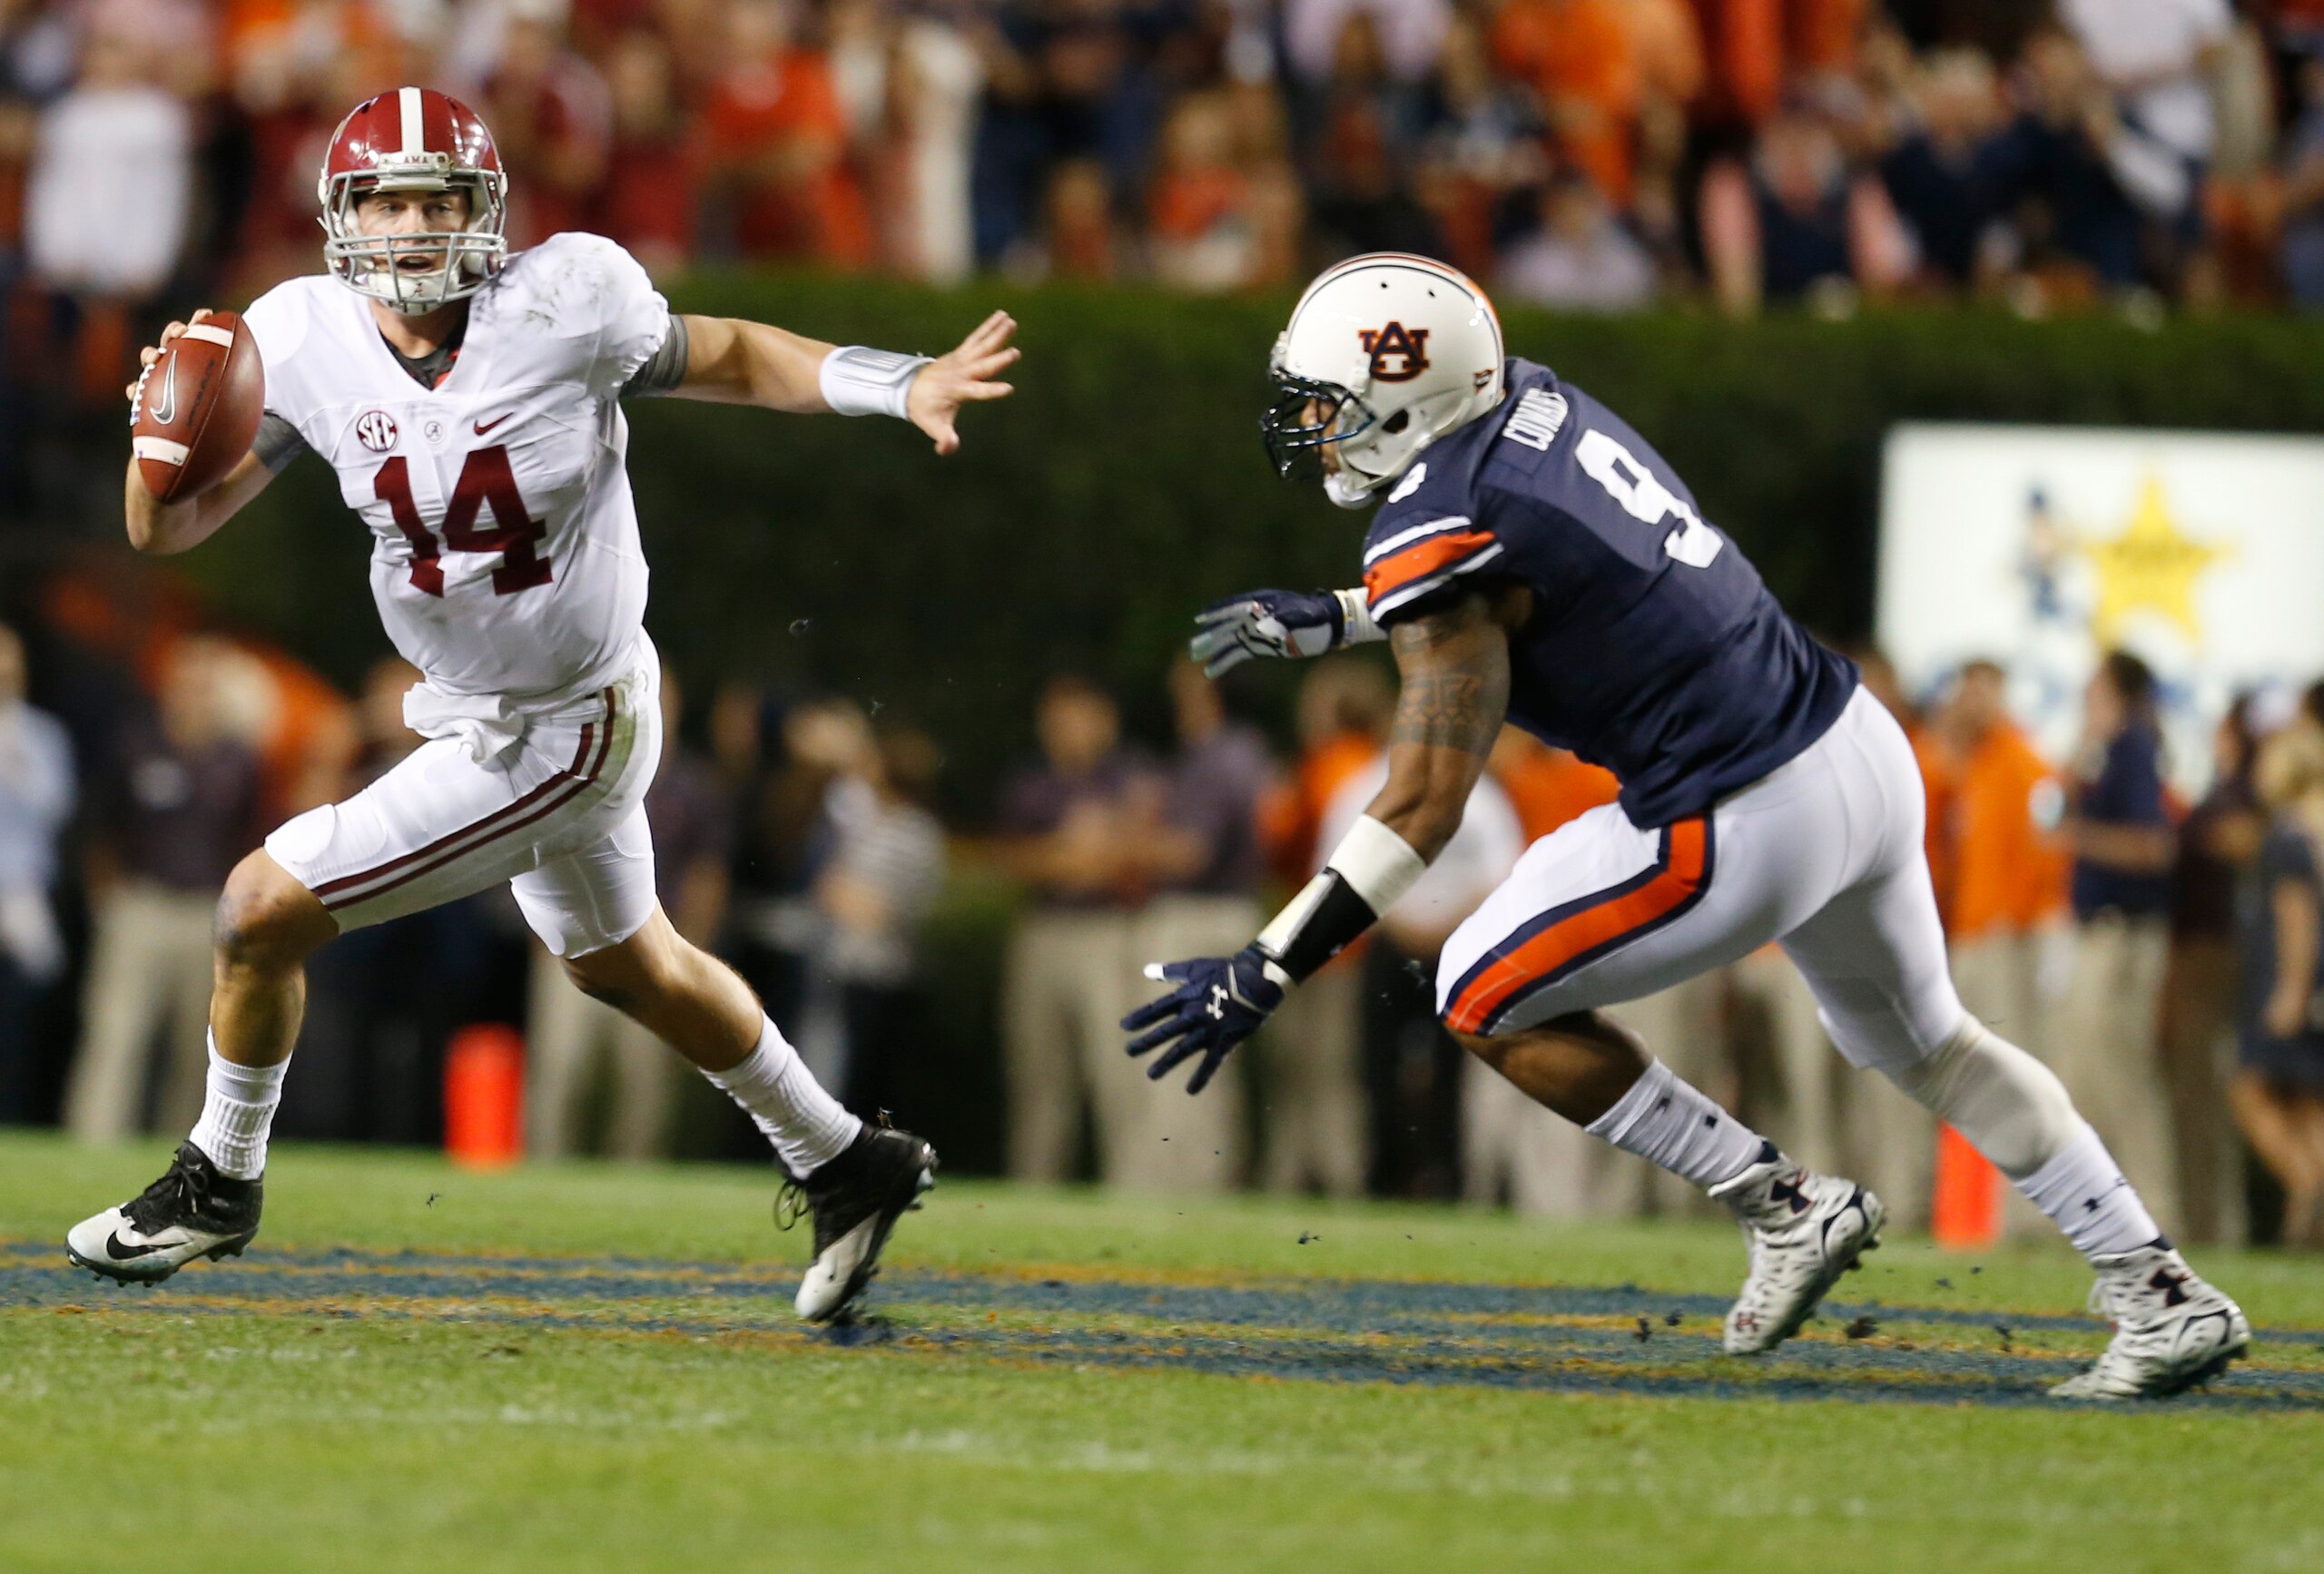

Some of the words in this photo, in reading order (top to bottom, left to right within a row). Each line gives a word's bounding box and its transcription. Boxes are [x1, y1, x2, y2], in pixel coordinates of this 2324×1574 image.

[356, 410, 398, 452] SEC
[1575, 428, 1724, 569] 9
[373, 444, 553, 599] 14
